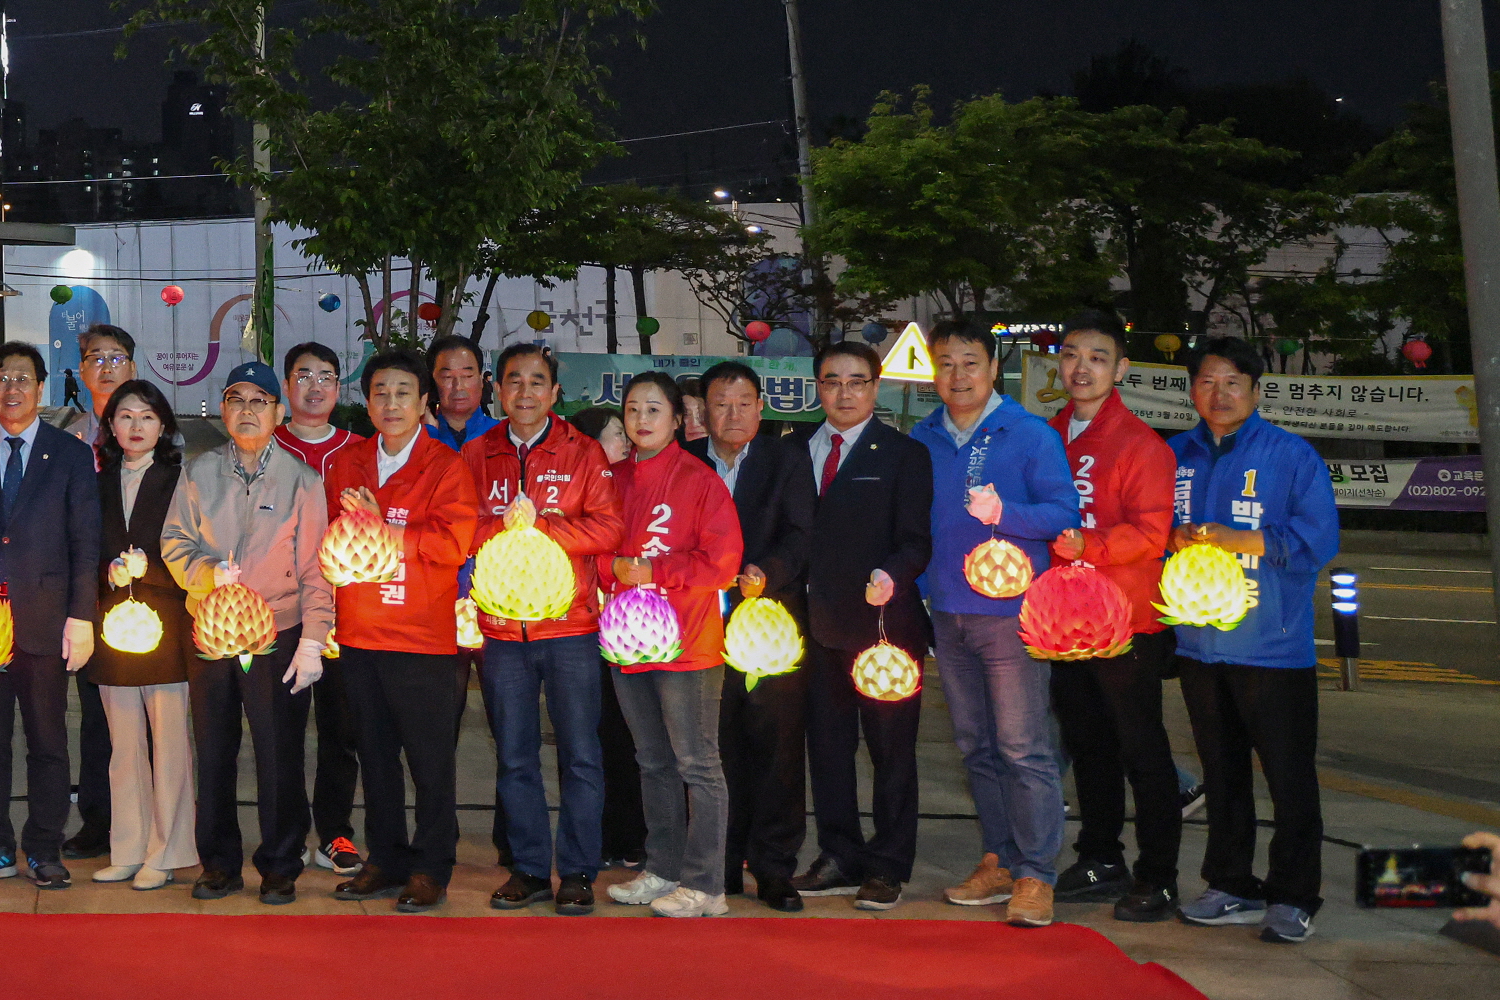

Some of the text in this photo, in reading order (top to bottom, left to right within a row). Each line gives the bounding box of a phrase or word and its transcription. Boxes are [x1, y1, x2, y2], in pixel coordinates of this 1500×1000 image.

[1152, 375, 1186, 391] 번째
[1288, 384, 1342, 401] 멈추지
[1350, 385, 1429, 403] 않습니다.
[1076, 455, 1095, 478] 2
[1351, 464, 1389, 484] 모집
[546, 485, 559, 504] 2
[1241, 468, 1257, 498] 1
[646, 503, 672, 534] 2
